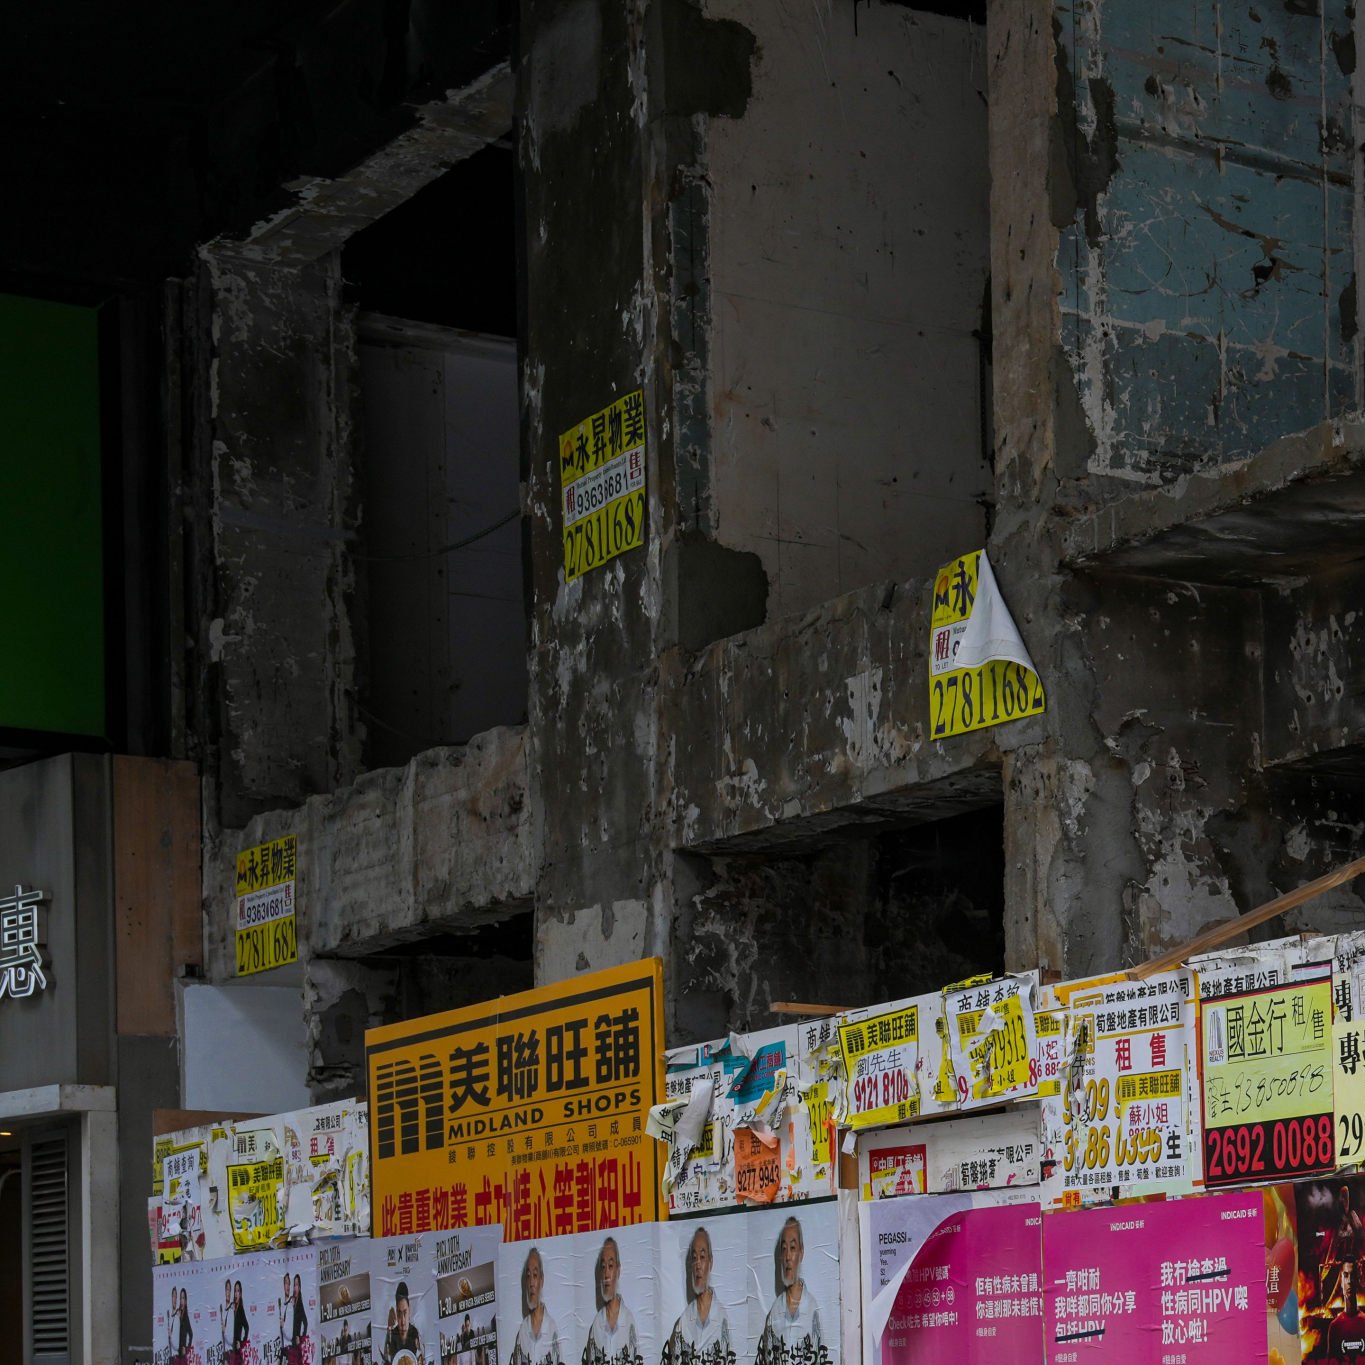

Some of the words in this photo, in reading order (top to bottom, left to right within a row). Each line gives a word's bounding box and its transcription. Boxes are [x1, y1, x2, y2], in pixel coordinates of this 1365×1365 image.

[575, 393, 643, 472] 永昇物業
[248, 838, 294, 890] 永昇物業
[239, 918, 295, 972] 27811682
[1096, 1002, 1181, 1033] 筍盤地產有限公司
[1226, 997, 1287, 1061] 國金行
[448, 1007, 640, 1113] 美聯旺舖
[857, 1049, 902, 1077] 劉先生
[1209, 1049, 1224, 1057] NEXUS
[854, 1075, 878, 1113] 9121
[883, 1069, 909, 1106] 8108
[448, 1107, 544, 1141] MIDLAND
[564, 1089, 642, 1118] SHOPS
[1208, 1123, 1265, 1176] 2692
[1273, 1115, 1331, 1170] 0088
[737, 1166, 757, 1193] 9277
[760, 1166, 780, 1189] 9943
[1110, 1221, 1135, 1232] INDICAID
[1221, 1210, 1246, 1220] INDICAID
[879, 1232, 907, 1244] PEGASSI
